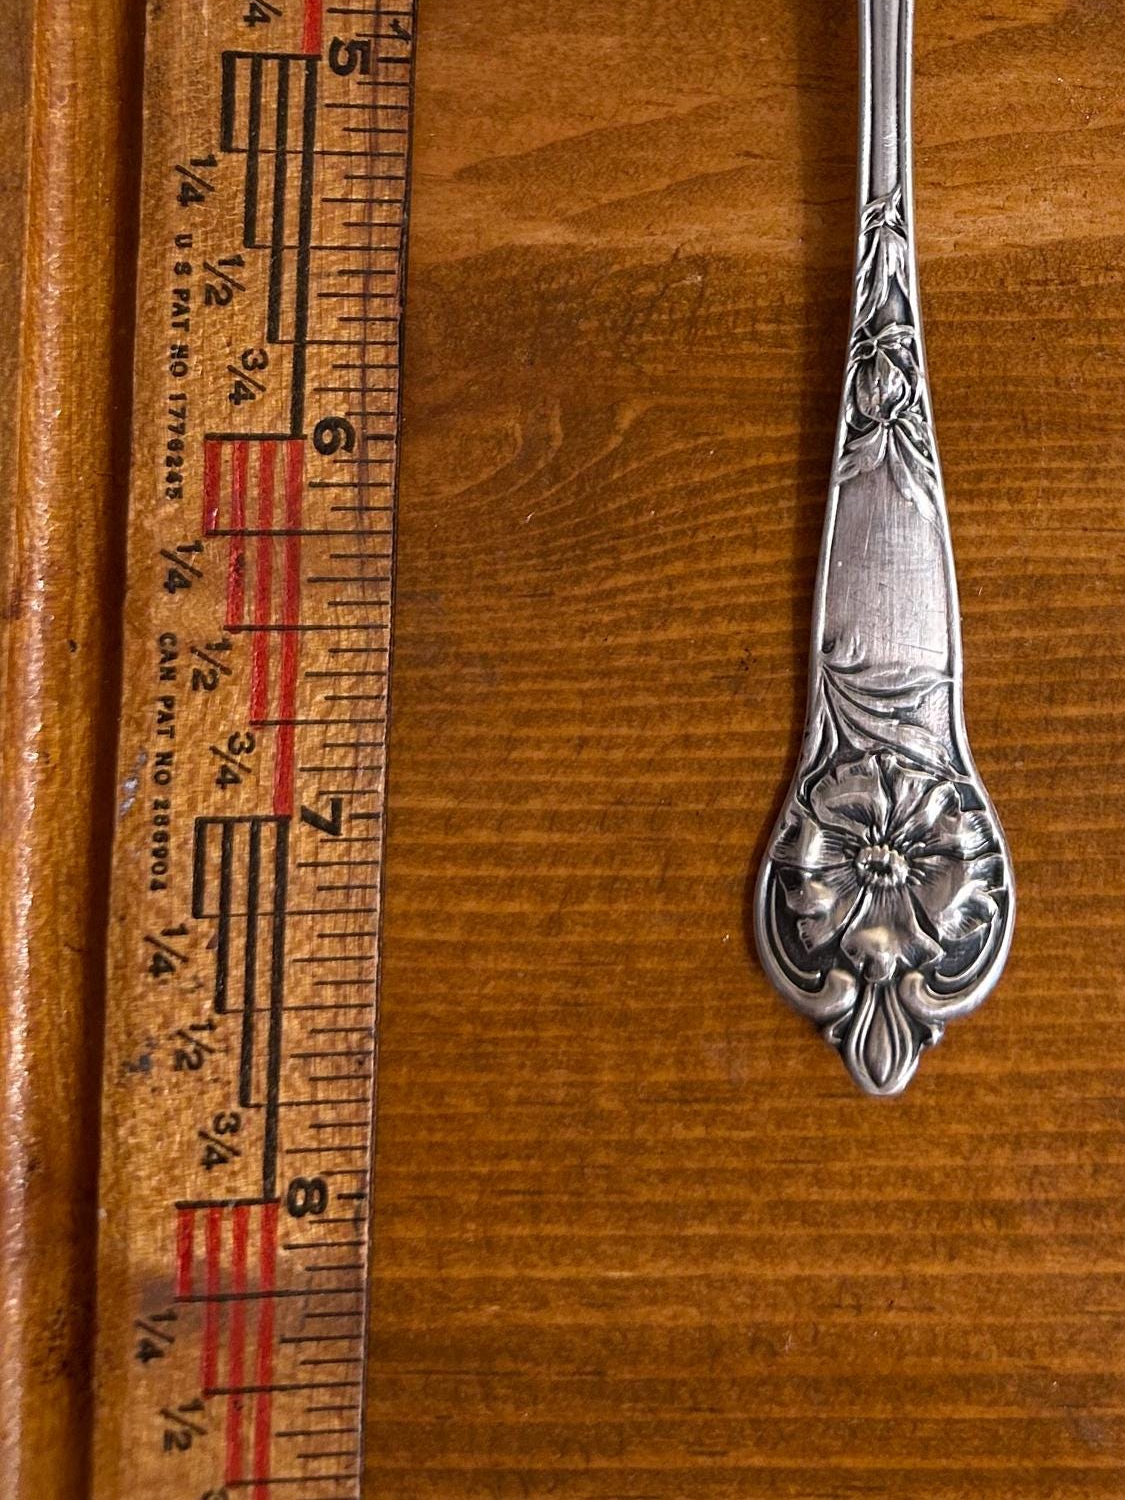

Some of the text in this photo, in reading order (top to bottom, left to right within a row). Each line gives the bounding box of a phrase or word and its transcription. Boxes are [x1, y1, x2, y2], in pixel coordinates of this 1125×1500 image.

[328, 36, 373, 77] 5
[175, 154, 218, 207] 1/4
[174, 233, 193, 249] U
[174, 261, 192, 277] S
[203, 254, 246, 308] 1/2
[171, 289, 191, 333] PAT
[169, 344, 189, 378] NO
[227, 348, 269, 406] 3/4
[313, 415, 356, 456] 6
[160, 540, 204, 595] 1/4
[158, 632, 178, 682] CAN
[190, 638, 233, 692] 1/2
[156, 695, 175, 740] PAT
[153, 752, 174, 787] NO
[209, 731, 256, 790] 3/4
[300, 797, 343, 837] 7
[144, 922, 189, 978] 1/4
[173, 1018, 217, 1072] 1/2
[198, 1111, 242, 1170] 3/4
[286, 1176, 328, 1218] 8
[134, 1310, 178, 1364] 1/4
[159, 1398, 207, 1453] 1/2
